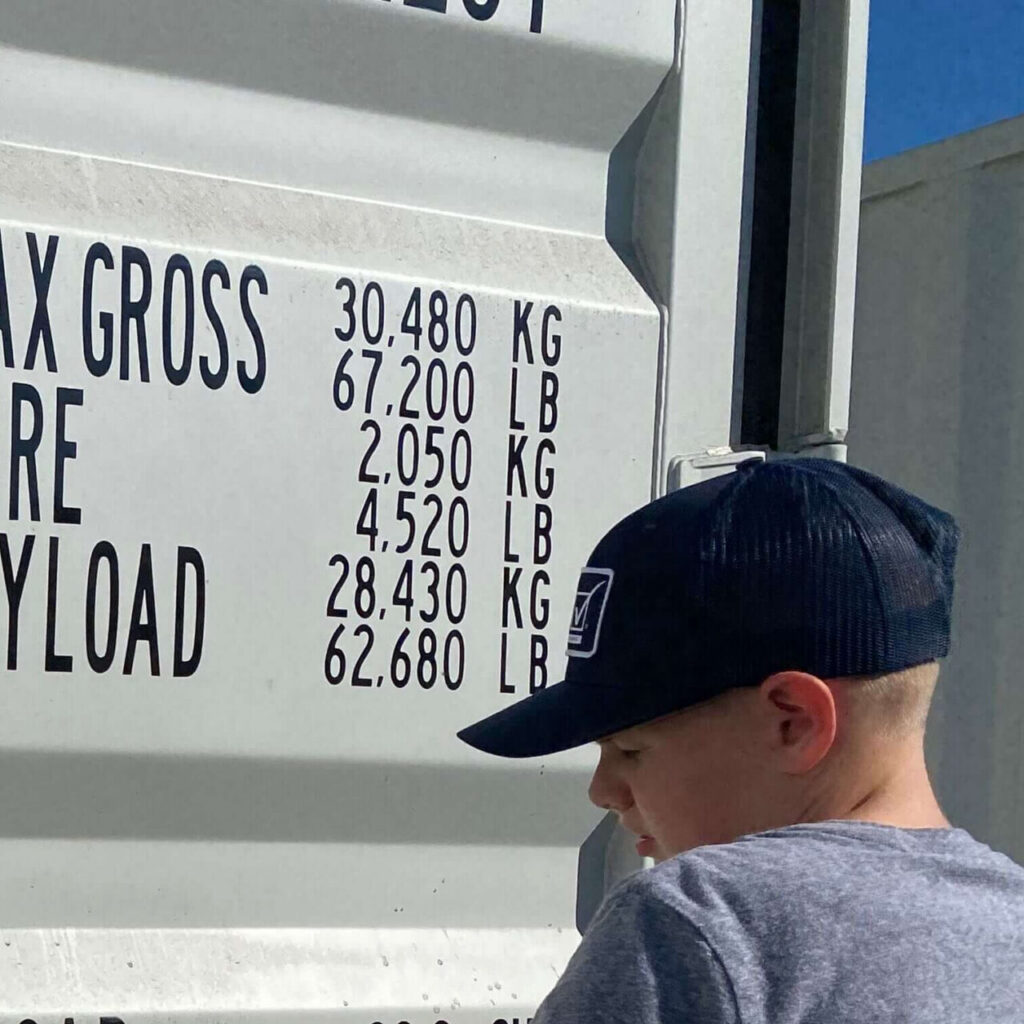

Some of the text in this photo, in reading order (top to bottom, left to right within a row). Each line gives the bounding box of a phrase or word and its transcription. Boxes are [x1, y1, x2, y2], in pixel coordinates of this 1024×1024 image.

[82, 241, 269, 395] GROSS
[334, 277, 562, 367] 30,480 KG
[332, 348, 559, 434] 67,200 LB
[358, 419, 556, 500] 2,050 KG
[356, 487, 553, 565] 4,520 LB
[326, 553, 551, 630] 28,430 KG
[324, 623, 549, 694] 62,680 LB
